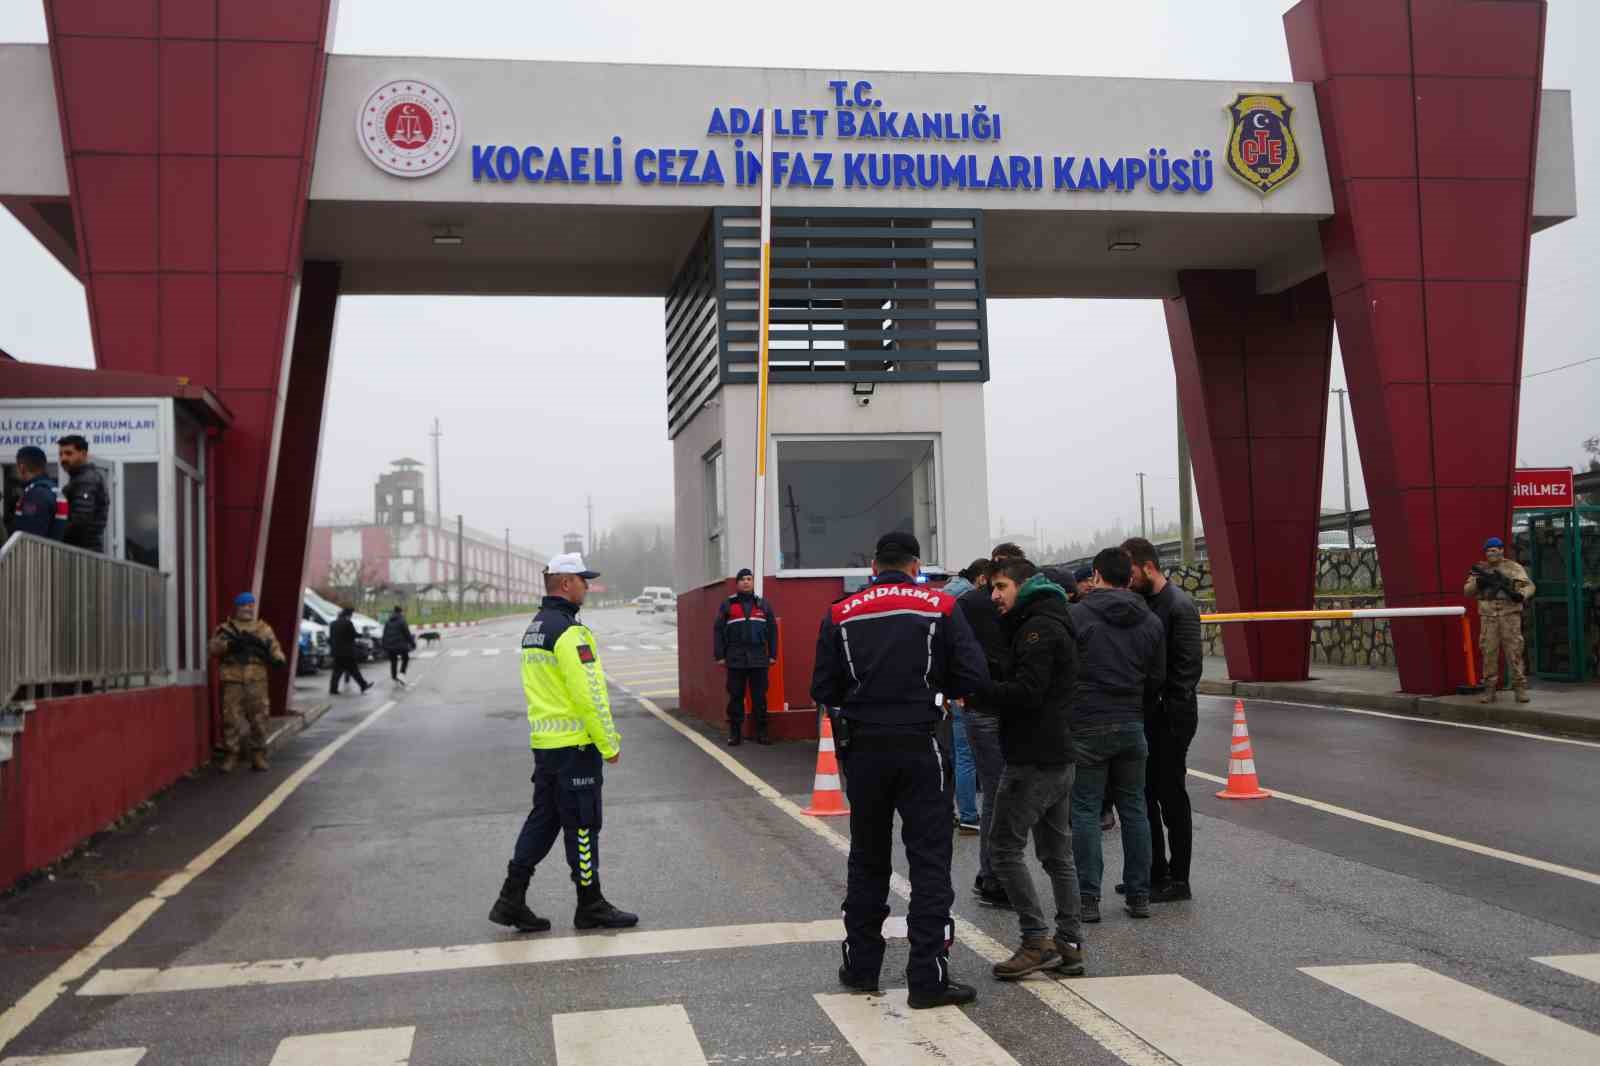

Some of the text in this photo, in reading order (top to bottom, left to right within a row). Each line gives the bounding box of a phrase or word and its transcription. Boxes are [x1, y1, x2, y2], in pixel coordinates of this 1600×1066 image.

[829, 80, 882, 108] T.C.
[707, 104, 1001, 140] ADALET BAKANLIĞI
[472, 135, 1214, 193] KOCAELİ CEZA İNFAZ KURUMLARI KAMPÜSÜ
[15, 420, 46, 431] CEZA
[86, 420, 155, 430] KURUMLARI
[842, 586, 941, 614] JANDARMA
